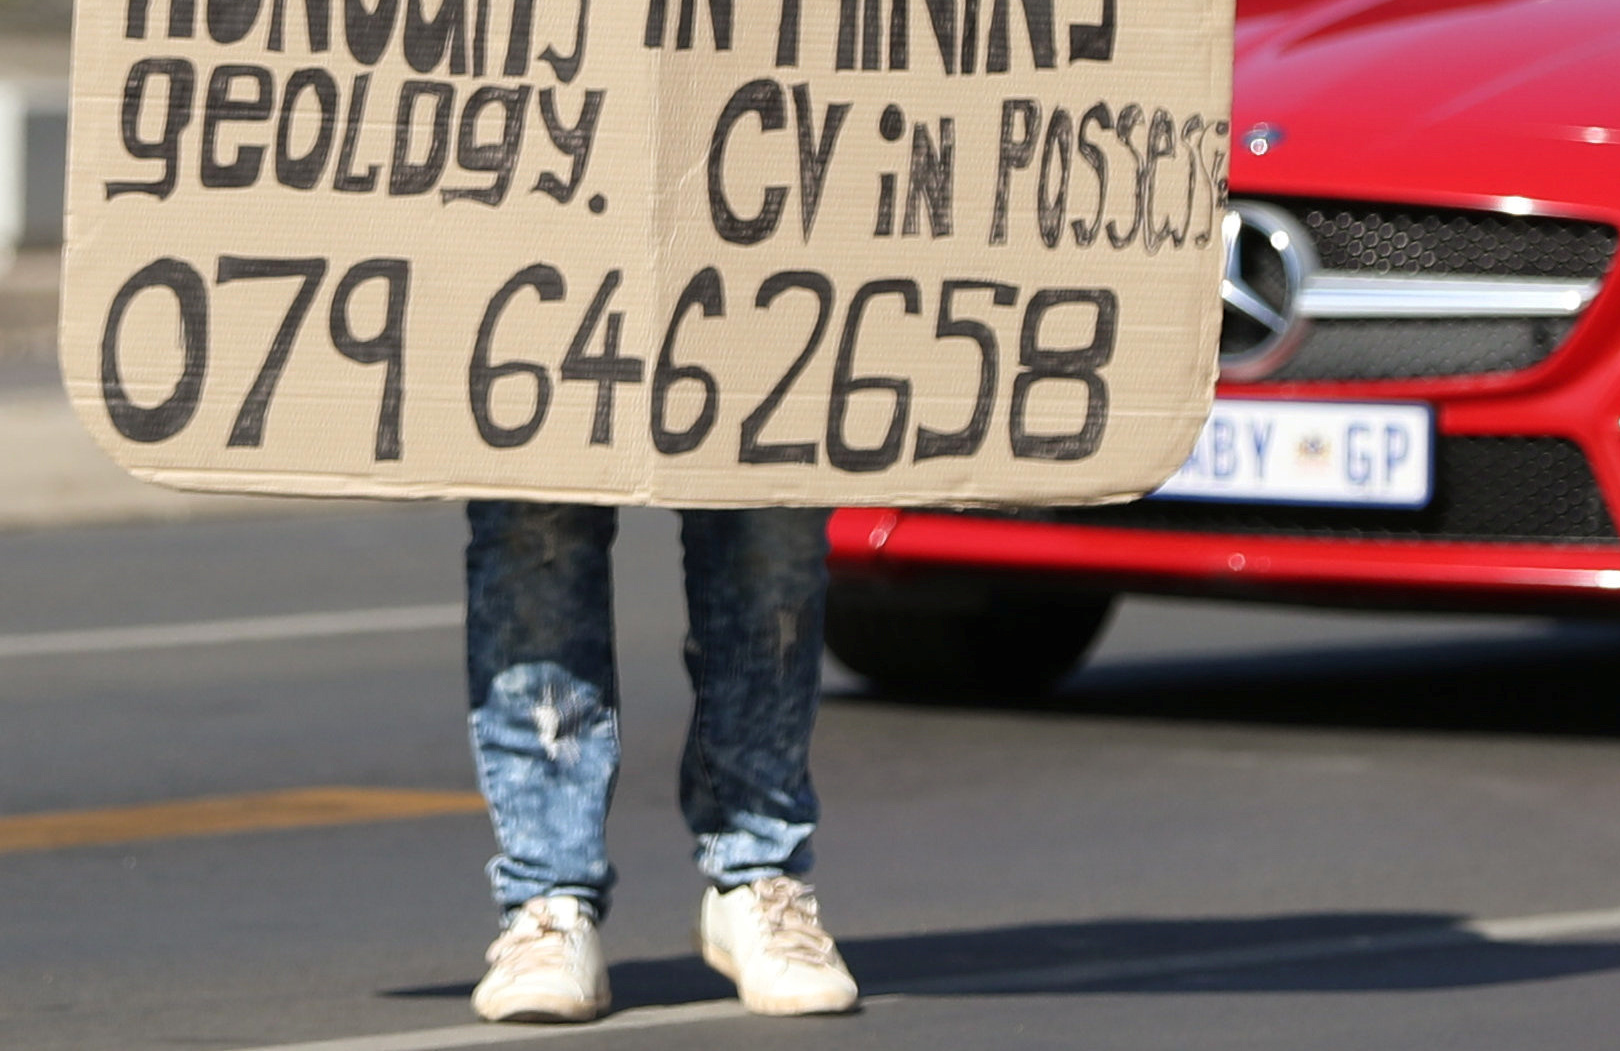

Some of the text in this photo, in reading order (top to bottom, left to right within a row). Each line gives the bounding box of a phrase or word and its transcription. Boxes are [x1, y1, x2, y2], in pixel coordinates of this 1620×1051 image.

[706, 78, 852, 246] CV
[100, 257, 1119, 472] 079 6462658
[1345, 421, 1410, 486] GP
